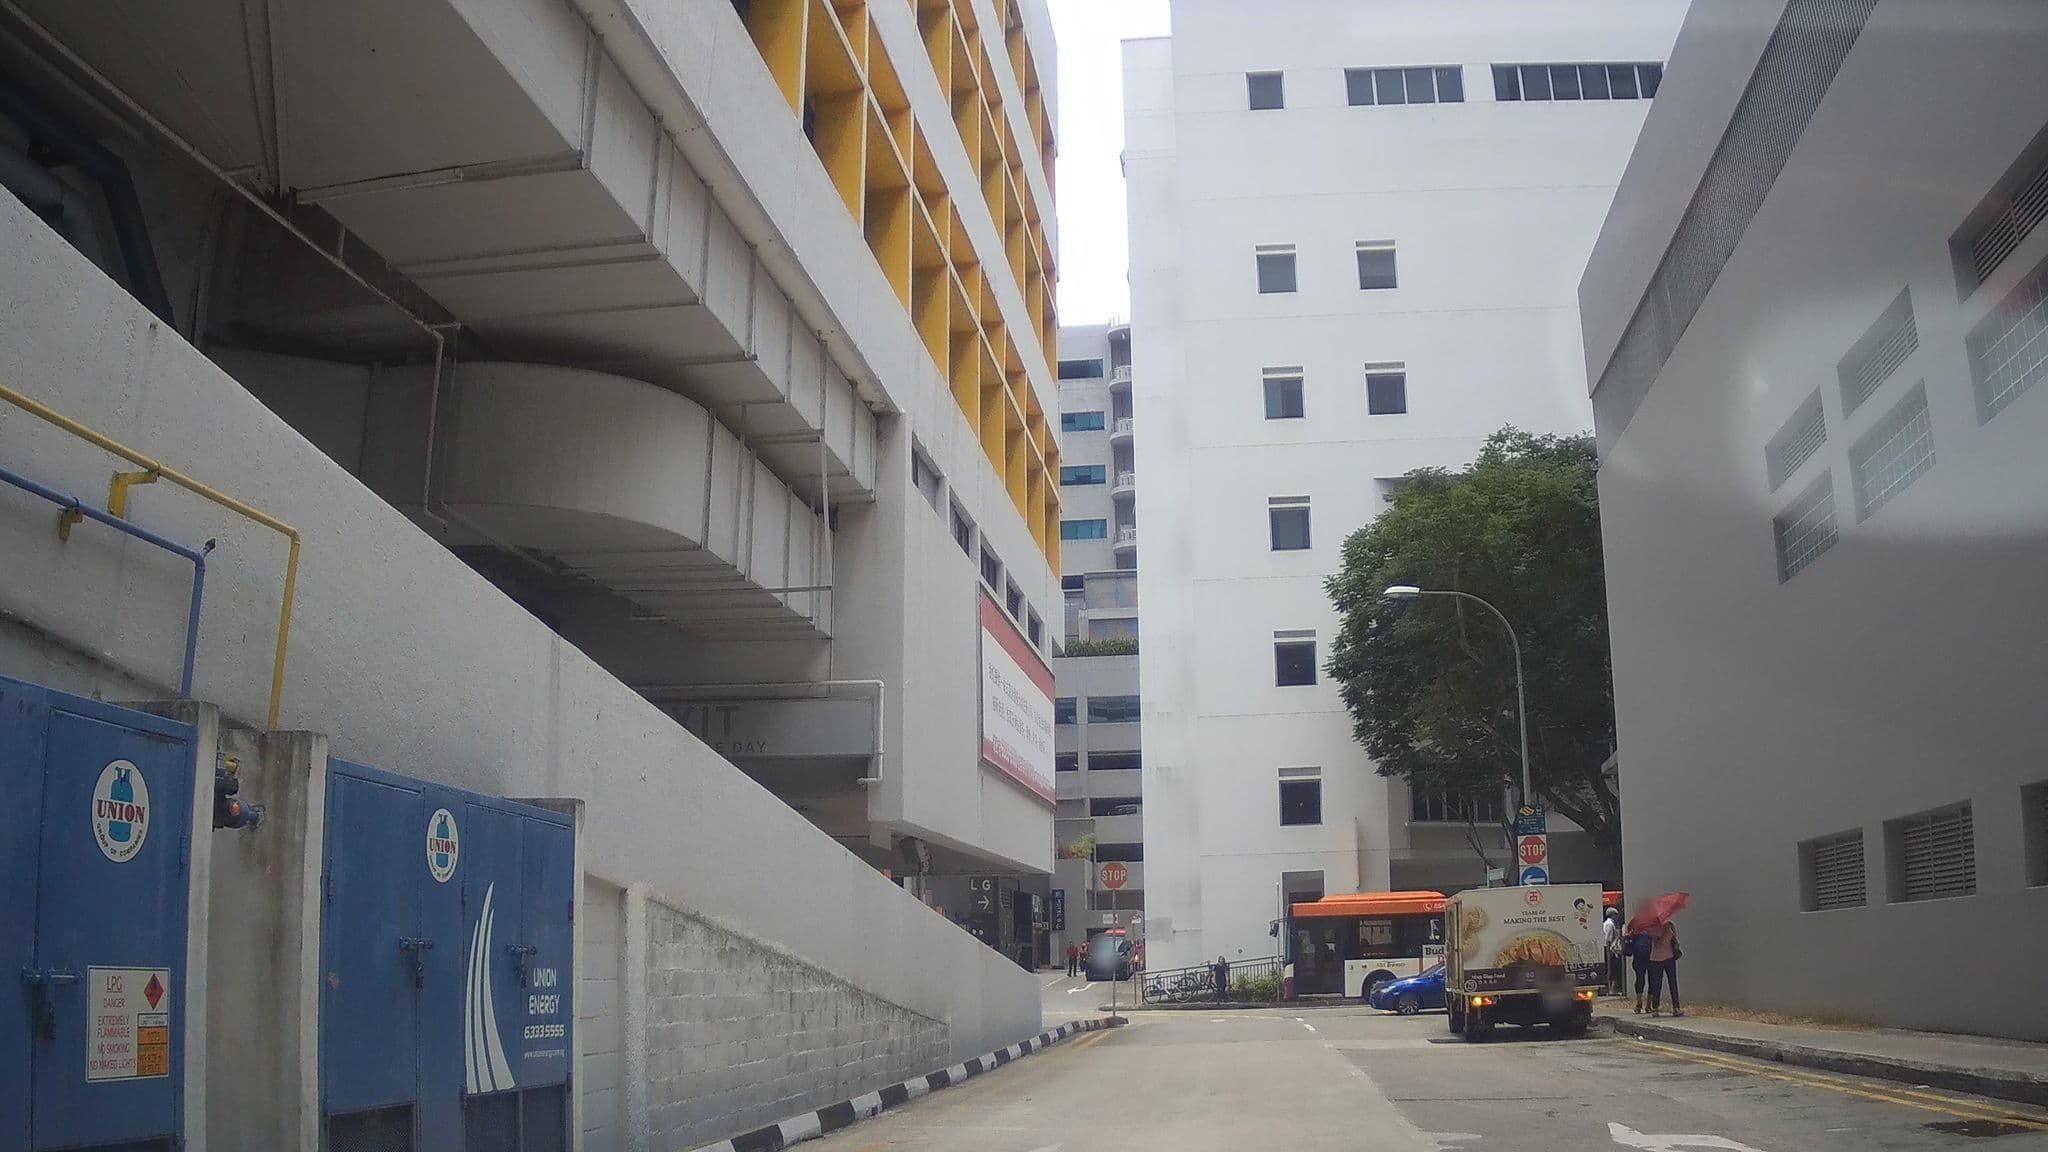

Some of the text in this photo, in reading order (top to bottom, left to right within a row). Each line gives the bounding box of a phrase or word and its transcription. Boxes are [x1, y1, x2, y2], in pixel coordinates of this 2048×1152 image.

[97, 799, 145, 824] UNION
[429, 837, 457, 855] UNION
[1520, 844, 1545, 857] STOP
[1102, 869, 1126, 881] STOP
[1503, 917, 1532, 925] MAKING
[533, 968, 557, 988] UNION
[106, 976, 123, 993] LPG
[103, 998, 125, 1008] DANGER
[528, 995, 560, 1015] ENERGY
[97, 1015, 129, 1026] EXTREMELY
[97, 1027, 130, 1038] FLAMMABLE
[106, 1043, 130, 1054] SMOKING
